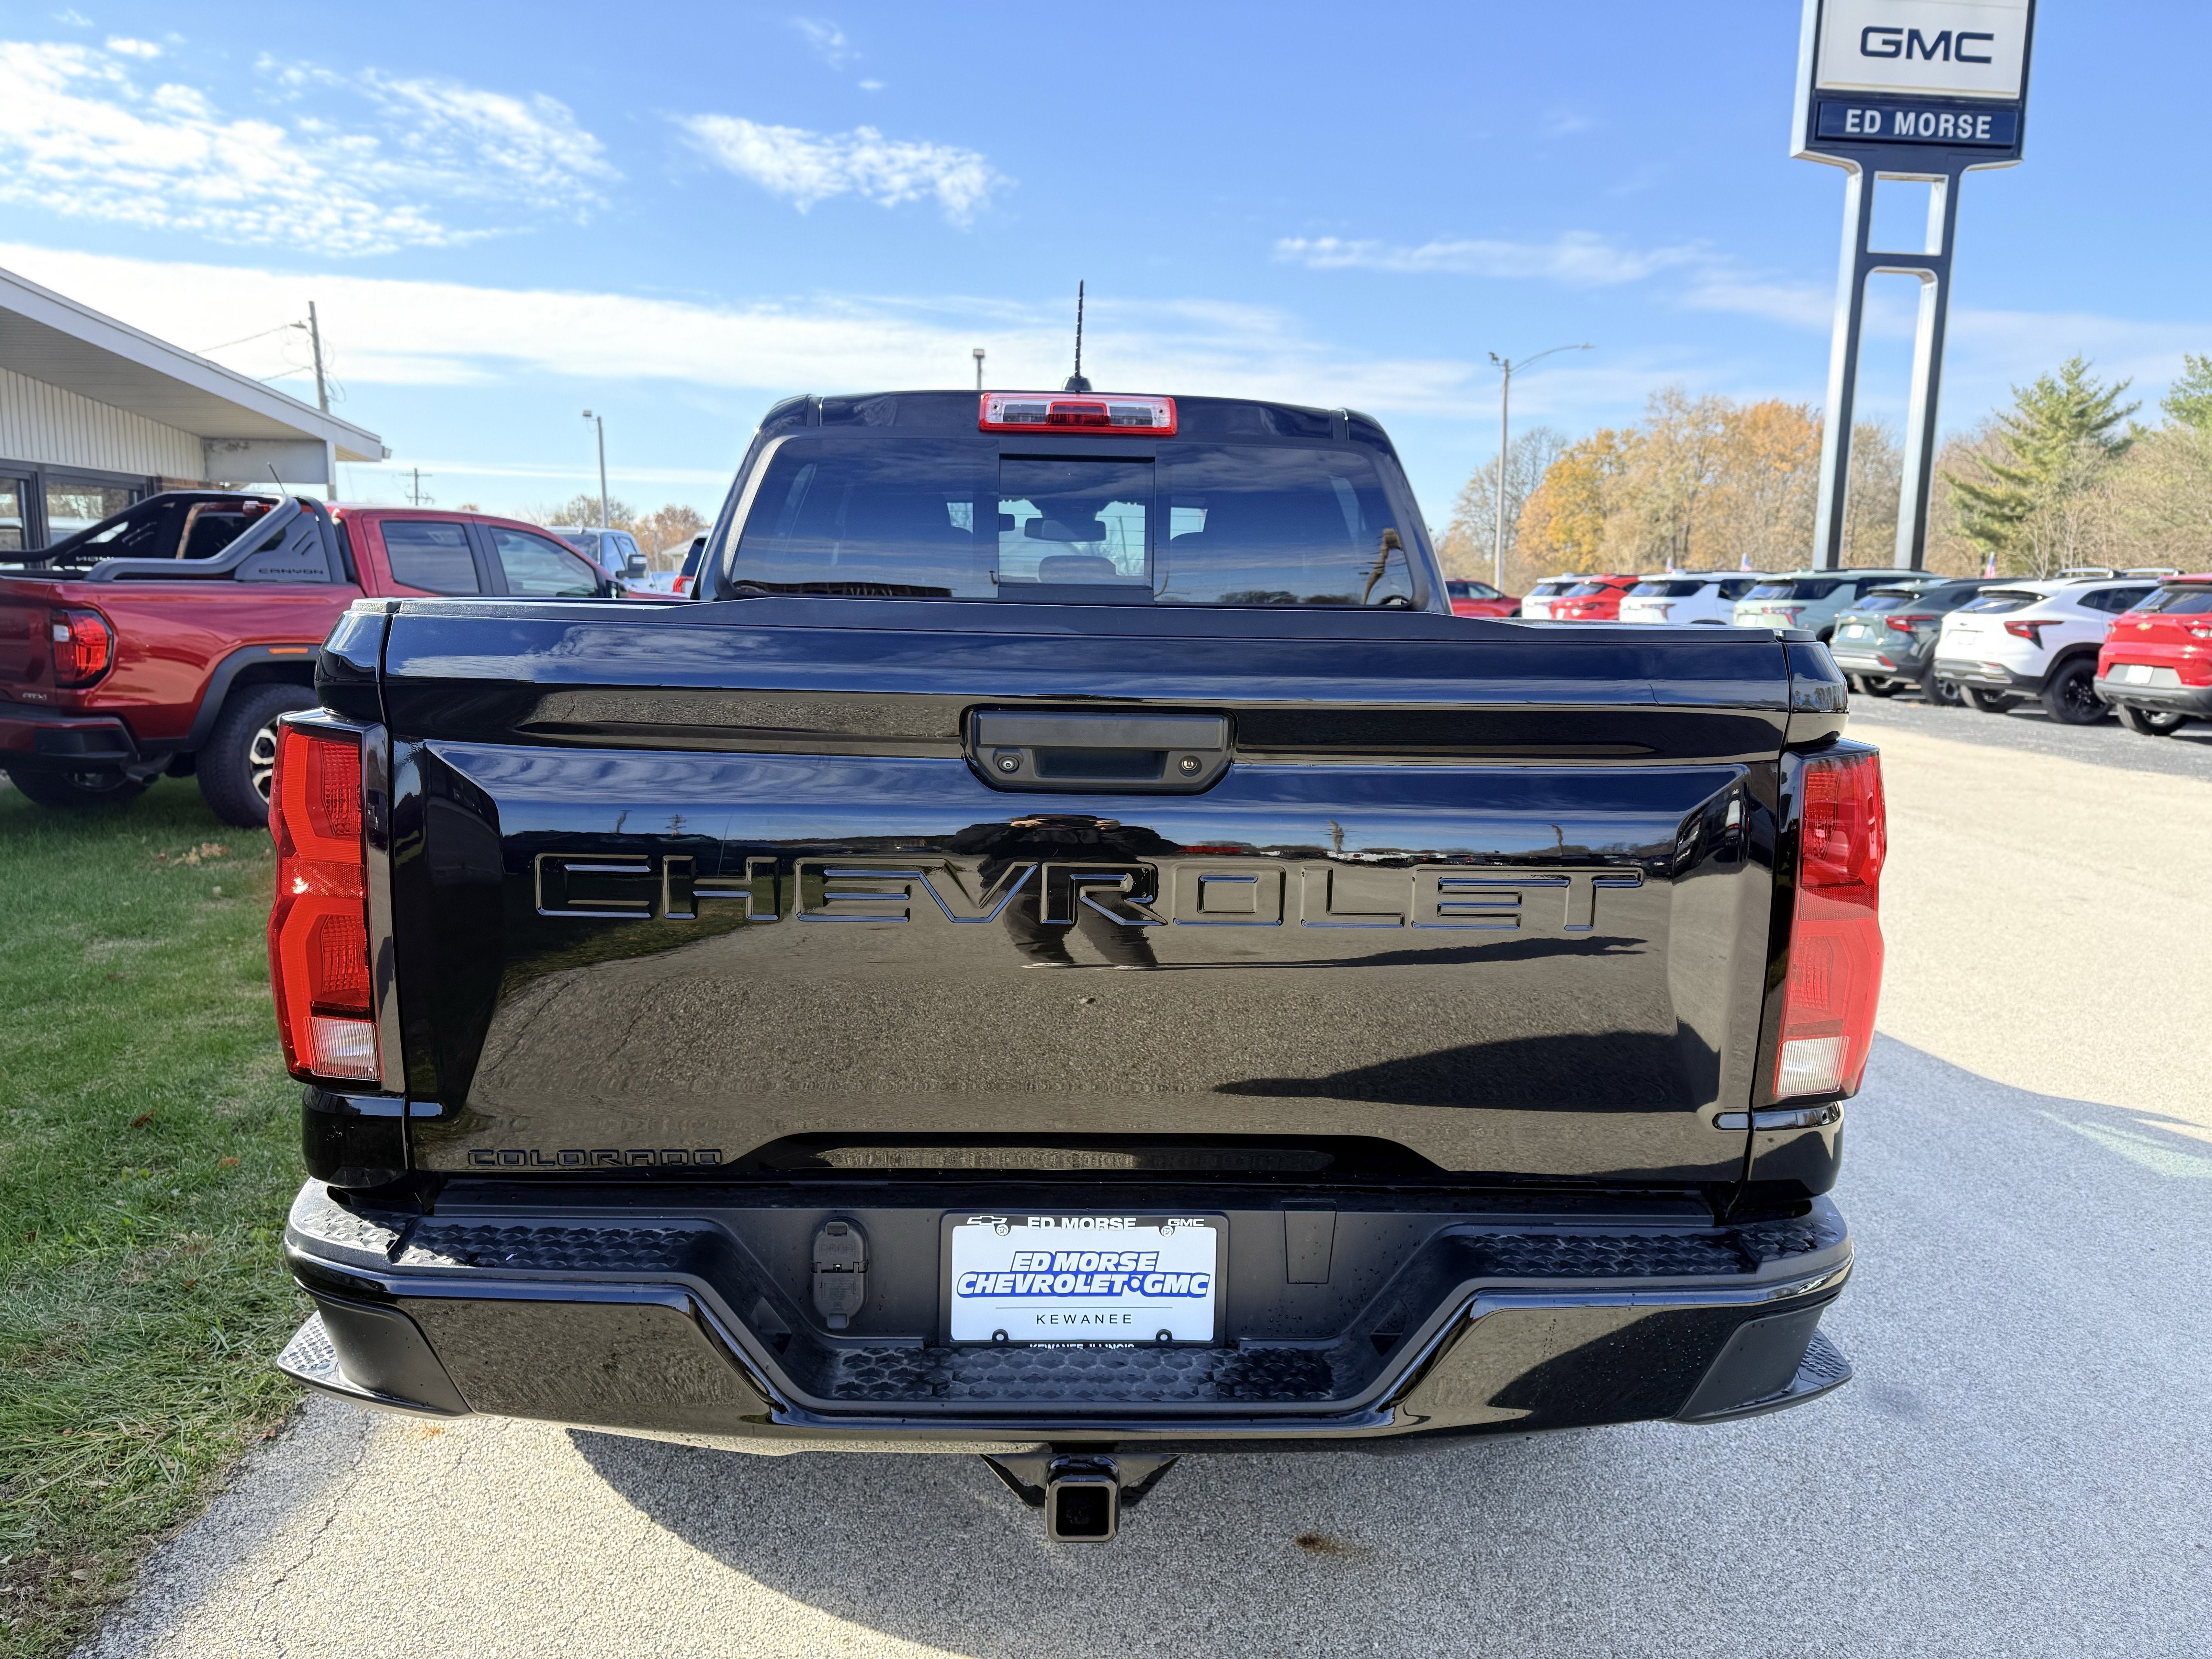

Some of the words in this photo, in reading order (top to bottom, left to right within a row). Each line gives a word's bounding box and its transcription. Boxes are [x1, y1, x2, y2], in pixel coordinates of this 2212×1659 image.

[1860, 26, 1994, 64] GMC
[1845, 109, 1881, 134] ED
[1894, 112, 1992, 139] MORSE
[536, 853, 1643, 931] CHEVROLET
[467, 1149, 723, 1166] COLORADO
[1027, 1217, 1055, 1230] ED
[1061, 1217, 1137, 1230] MORSE
[1168, 1218, 1204, 1227] GMC
[1011, 1252, 1050, 1271] ED
[1052, 1252, 1158, 1272] MORSE
[1036, 1314, 1132, 1324] KEWANEE
